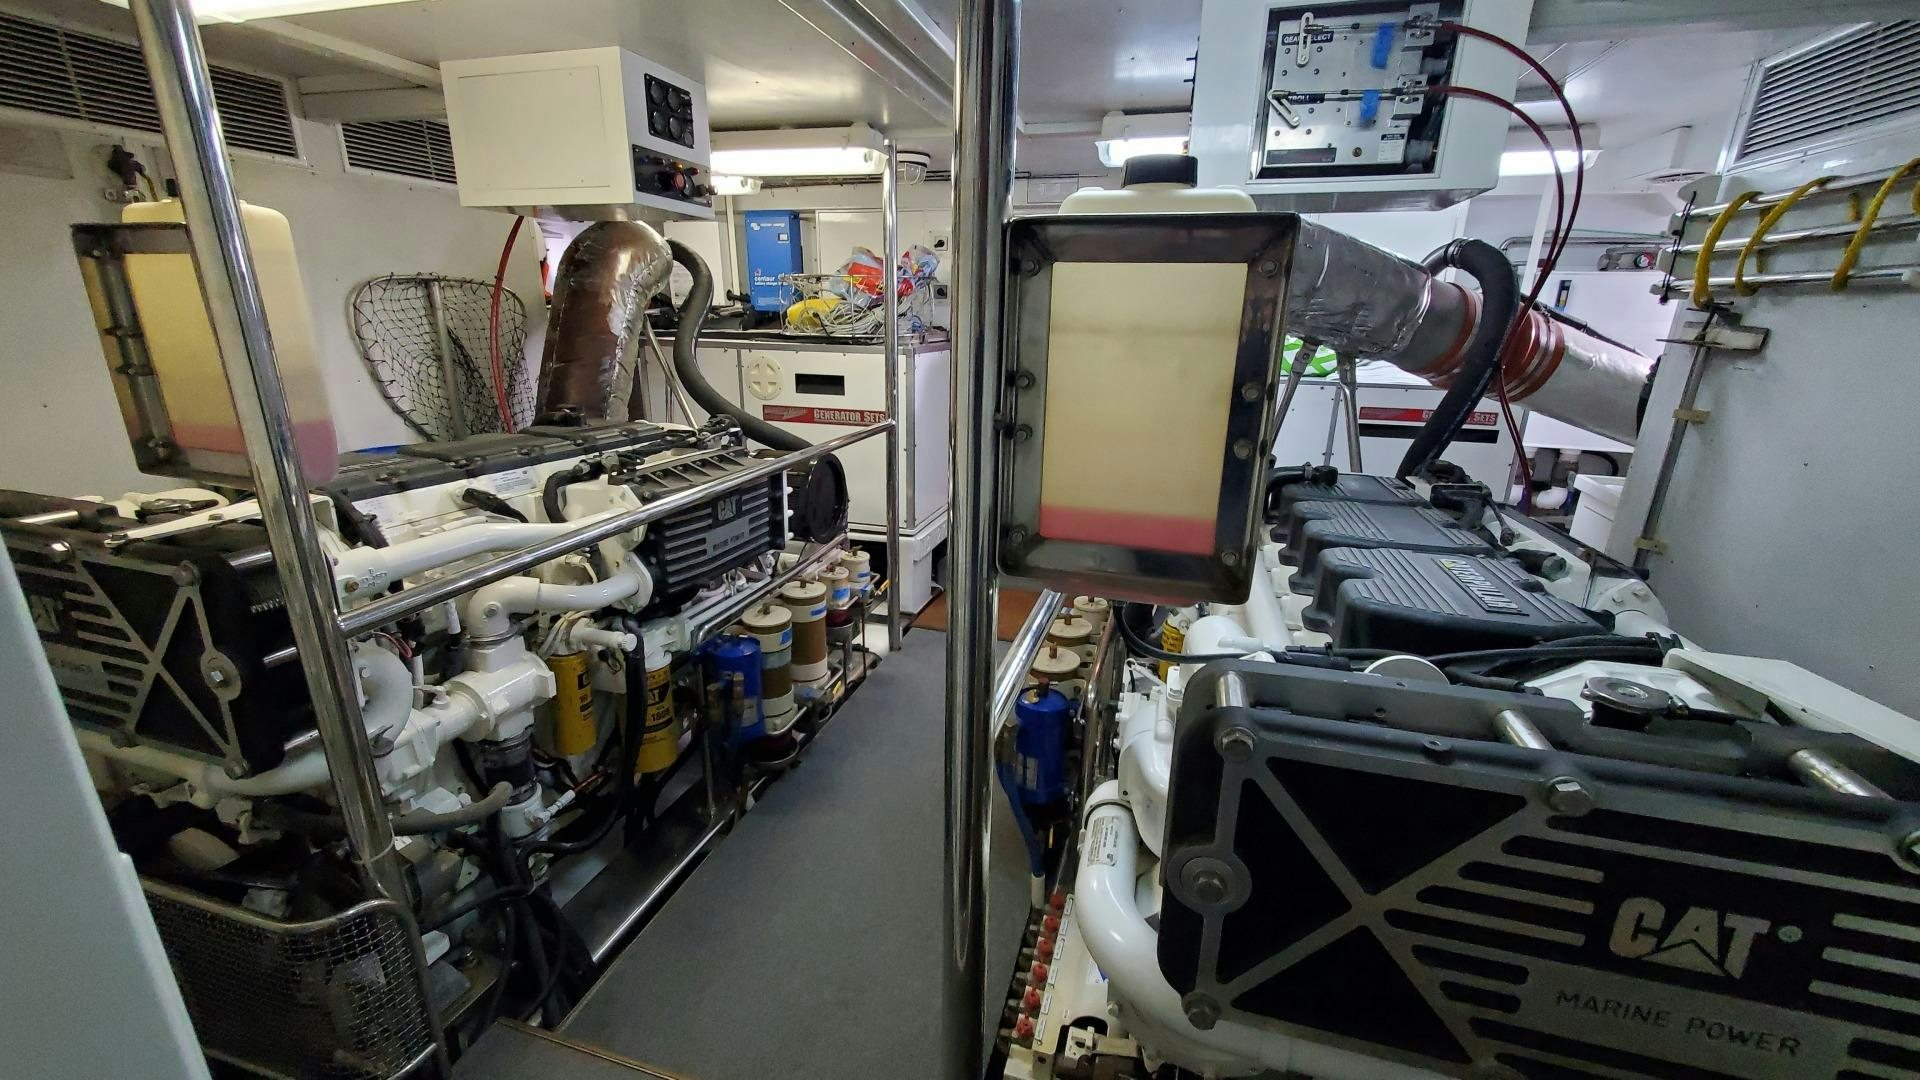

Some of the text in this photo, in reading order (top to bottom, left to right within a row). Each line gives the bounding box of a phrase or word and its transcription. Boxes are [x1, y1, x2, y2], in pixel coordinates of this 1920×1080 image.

[814, 409, 861, 422] GENERATOR
[864, 412, 886, 423] SETS
[717, 494, 738, 521] CAT
[1609, 897, 1772, 980] CAT
[1555, 990, 1801, 1056] MARINE POWER
